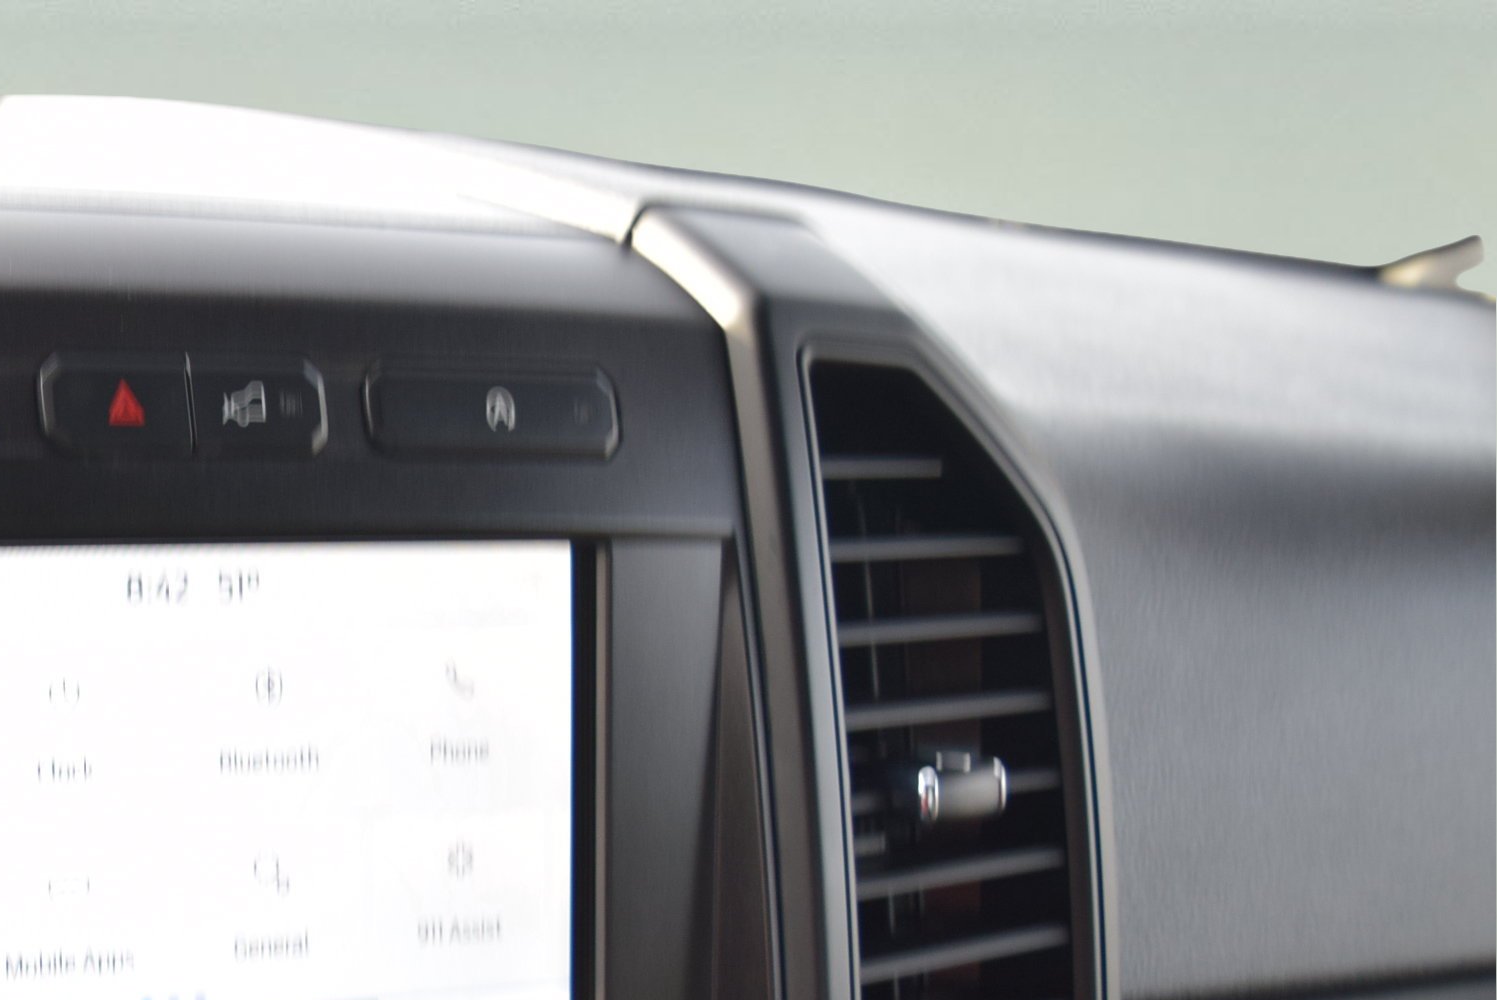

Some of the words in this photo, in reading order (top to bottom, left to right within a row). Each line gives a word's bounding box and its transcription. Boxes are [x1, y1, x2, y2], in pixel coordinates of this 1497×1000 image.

[219, 743, 320, 774] Bluetooth
[429, 736, 490, 765] Phone
[233, 927, 309, 960] General
[449, 914, 503, 944] Assist
[5, 948, 76, 980] Mobile
